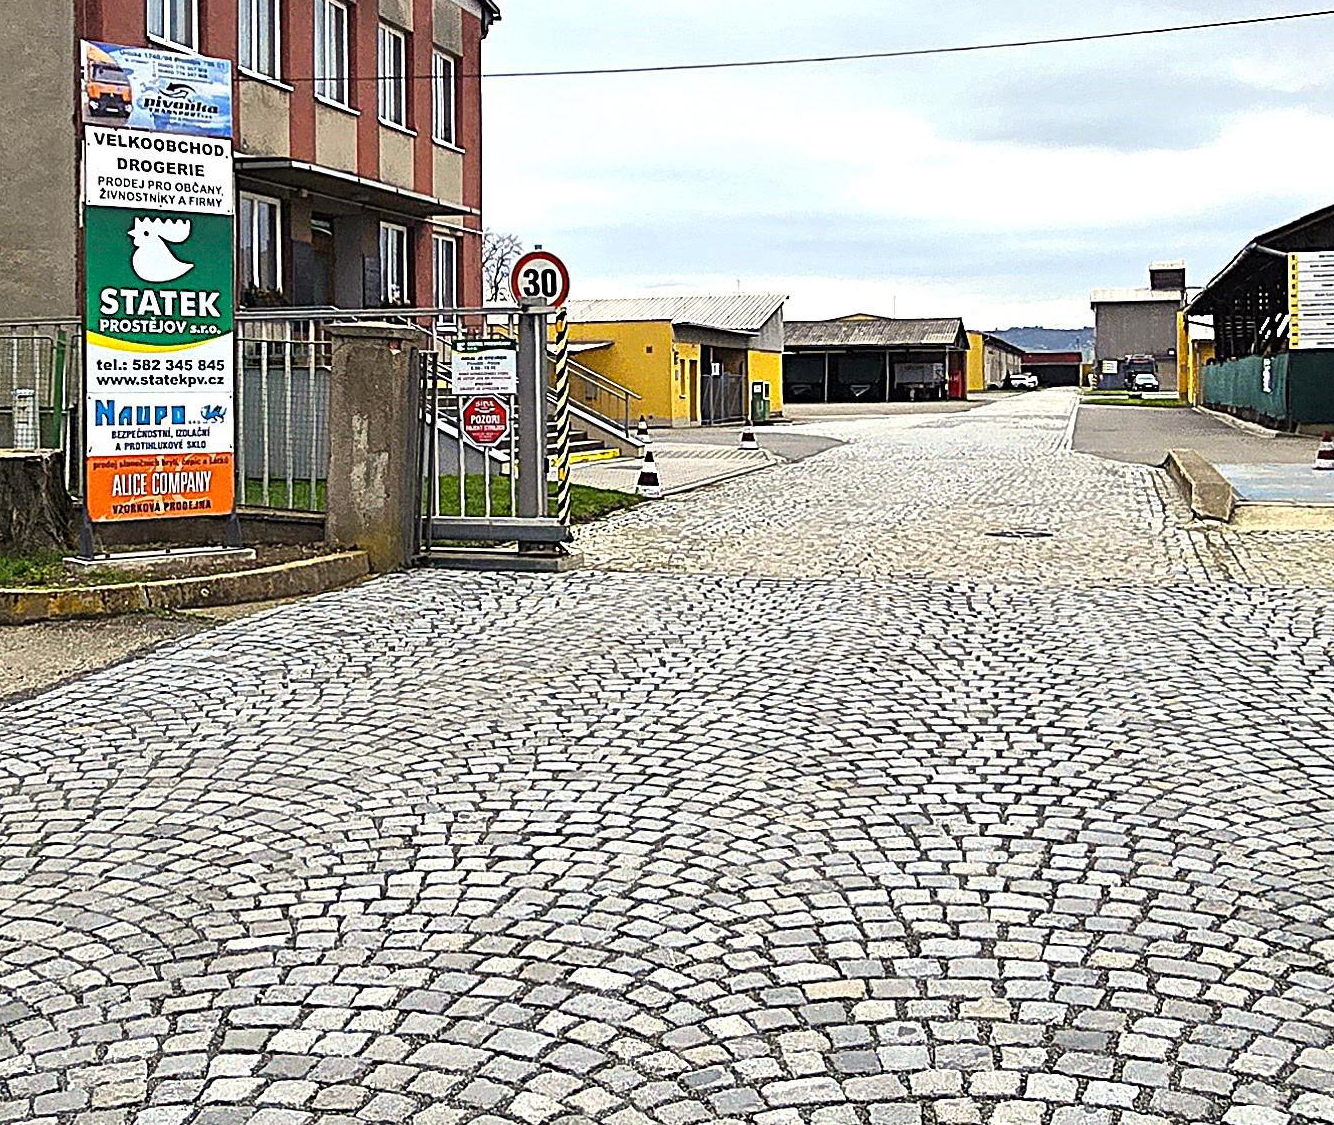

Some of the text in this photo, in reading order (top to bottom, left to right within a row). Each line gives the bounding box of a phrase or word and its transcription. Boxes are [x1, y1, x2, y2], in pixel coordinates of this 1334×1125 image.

[94, 132, 224, 157] VELKOOBCHOD
[117, 157, 205, 177] DROGERIE
[98, 176, 224, 197] PRODEJ PRO OBČANY,
[99, 188, 222, 208] ŽIVNOSTNÍKY A FIRMY
[523, 268, 558, 297] 30
[100, 288, 221, 318] STATEK
[99, 316, 222, 334] PROSTĚJOV s.r.o.
[96, 359, 225, 371] tel.: 582 345 845
[96, 374, 225, 387] www.statekpv.cz
[111, 426, 210, 439] BEZPEČNOSTNÍ, IZOLAČNÍ
[115, 439, 207, 451] A PROTIHLUKOVÉ SKLO
[93, 460, 118, 470] prodej
[112, 470, 212, 496] ALICE COMPANY
[112, 499, 211, 514] VZORKOVÁ PRODEJNA
